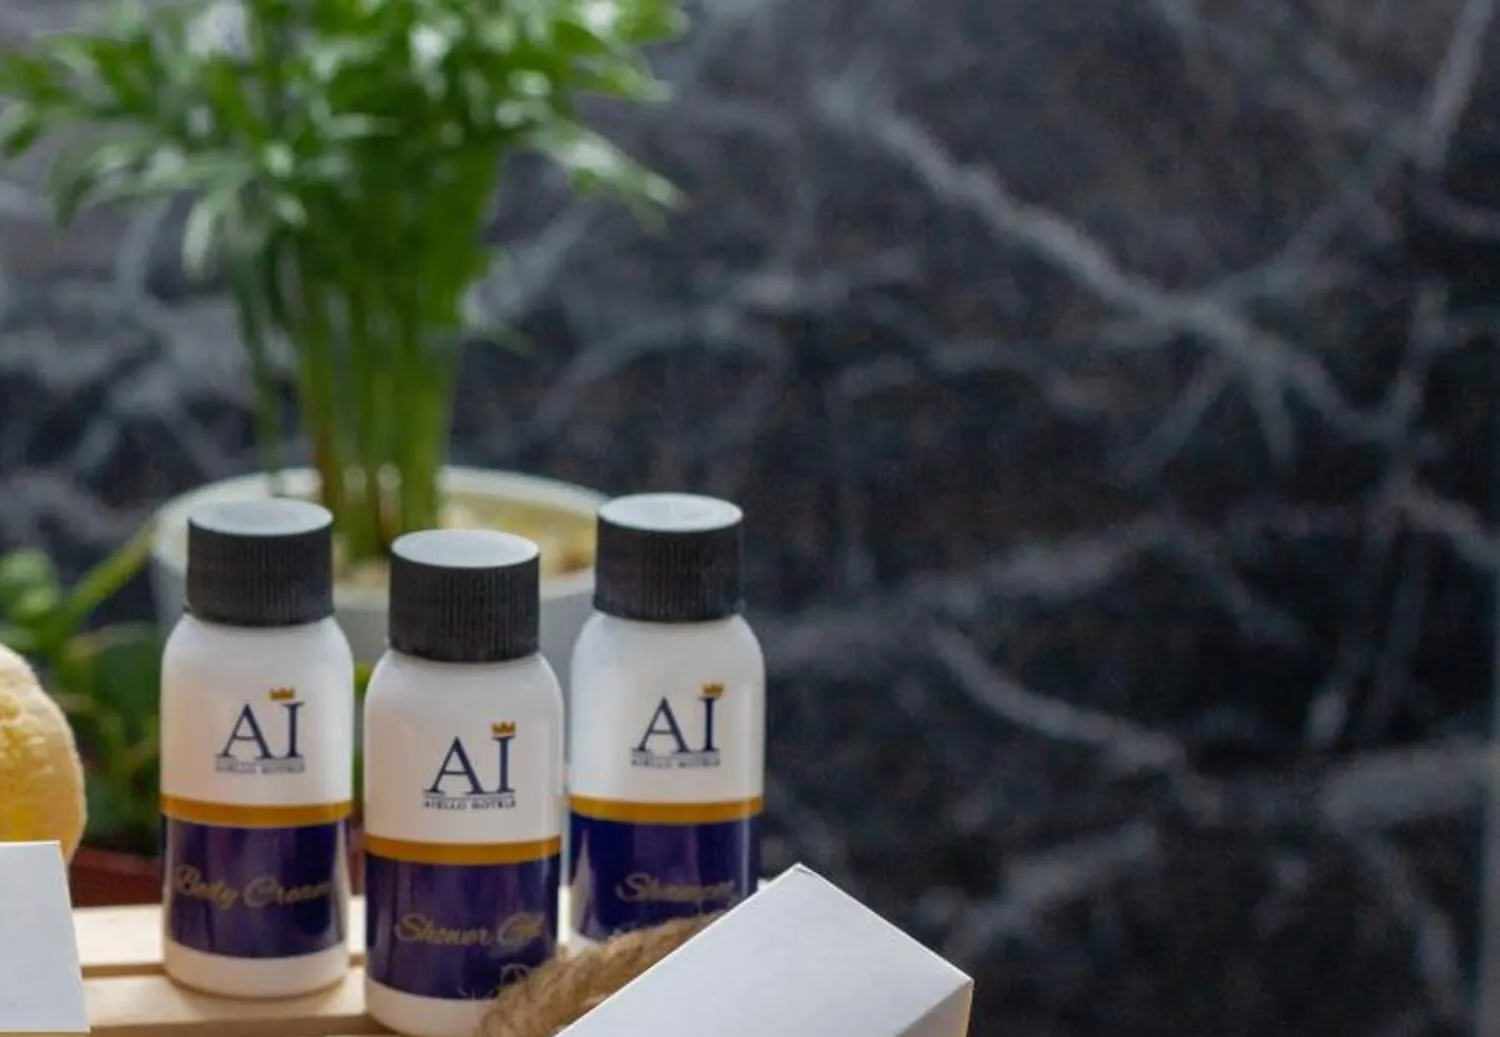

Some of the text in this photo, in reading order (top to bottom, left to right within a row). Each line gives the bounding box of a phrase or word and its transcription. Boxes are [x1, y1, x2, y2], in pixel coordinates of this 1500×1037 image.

[216, 702, 304, 759] AI
[632, 696, 720, 752] AI
[424, 735, 515, 794] AI
